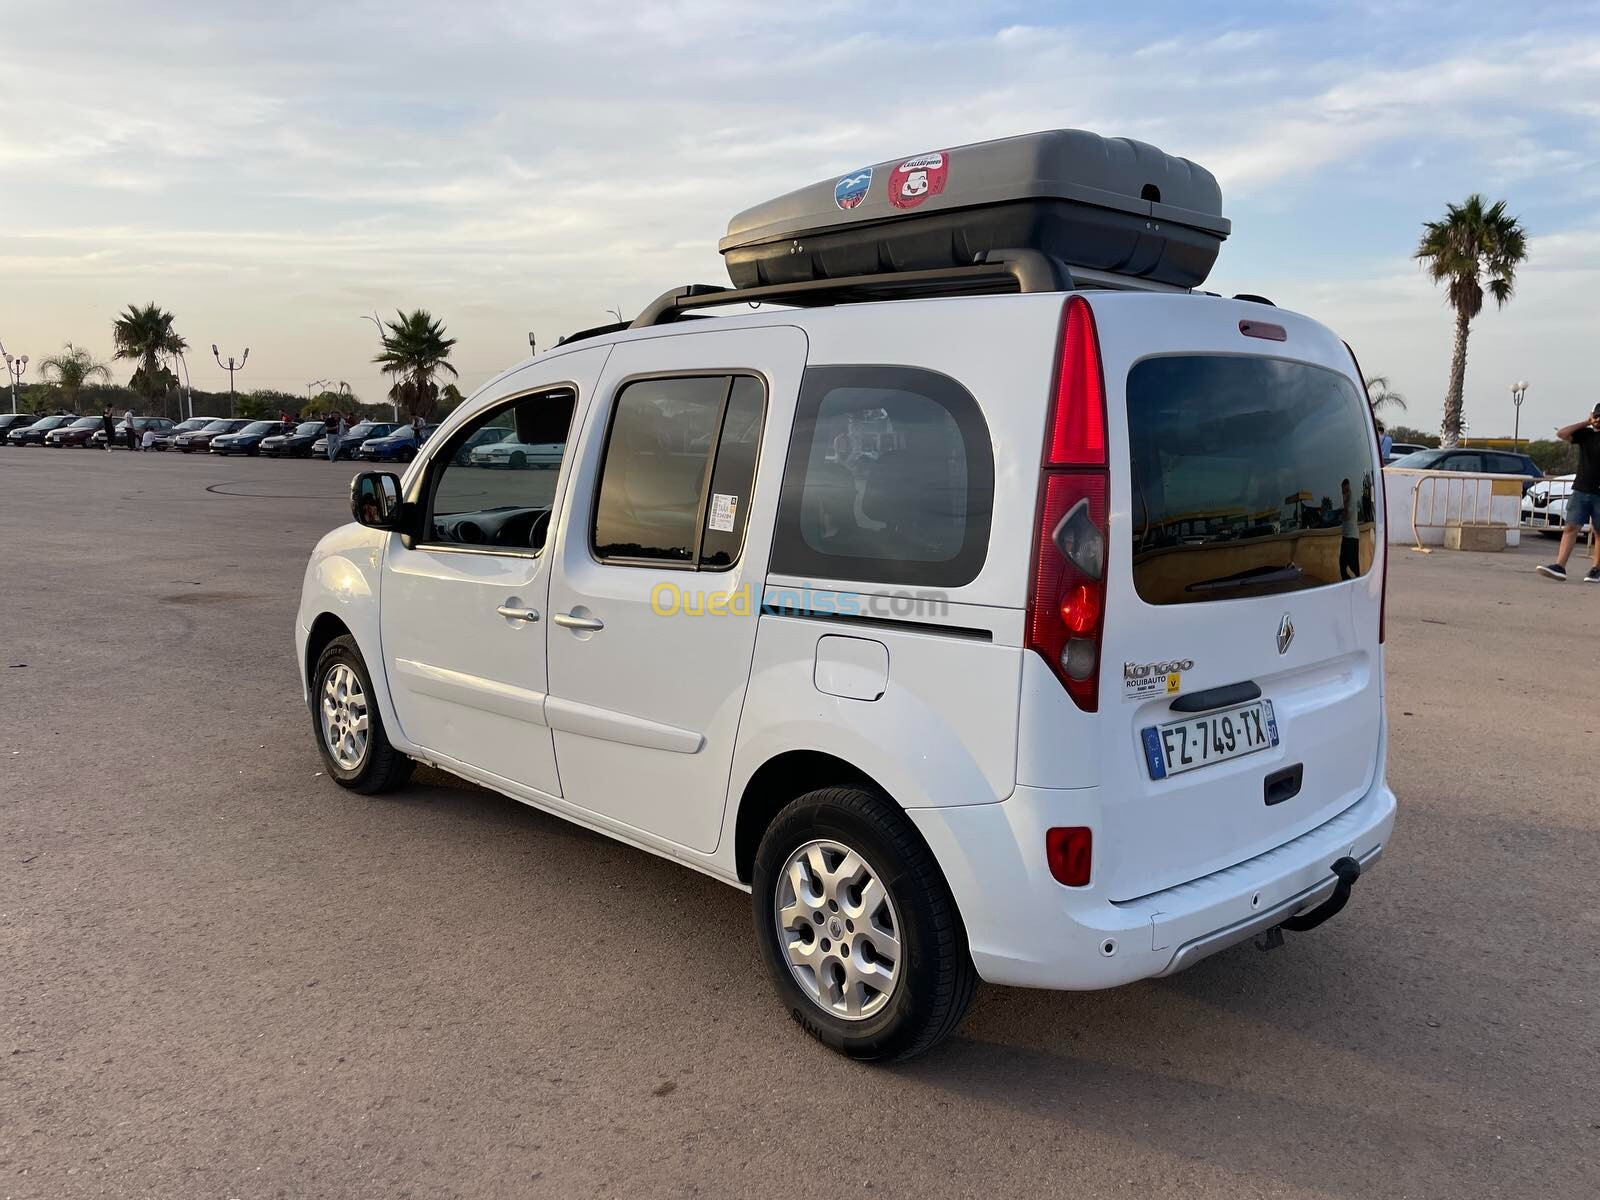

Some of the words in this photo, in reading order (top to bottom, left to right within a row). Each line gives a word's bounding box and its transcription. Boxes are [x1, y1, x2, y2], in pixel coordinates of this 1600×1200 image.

[1124, 659, 1193, 679] Kangoo
[1126, 675, 1167, 688] ROUIBAUTO
[1162, 708, 1266, 768] FZ-749-TX
[1154, 756, 1159, 769] F
